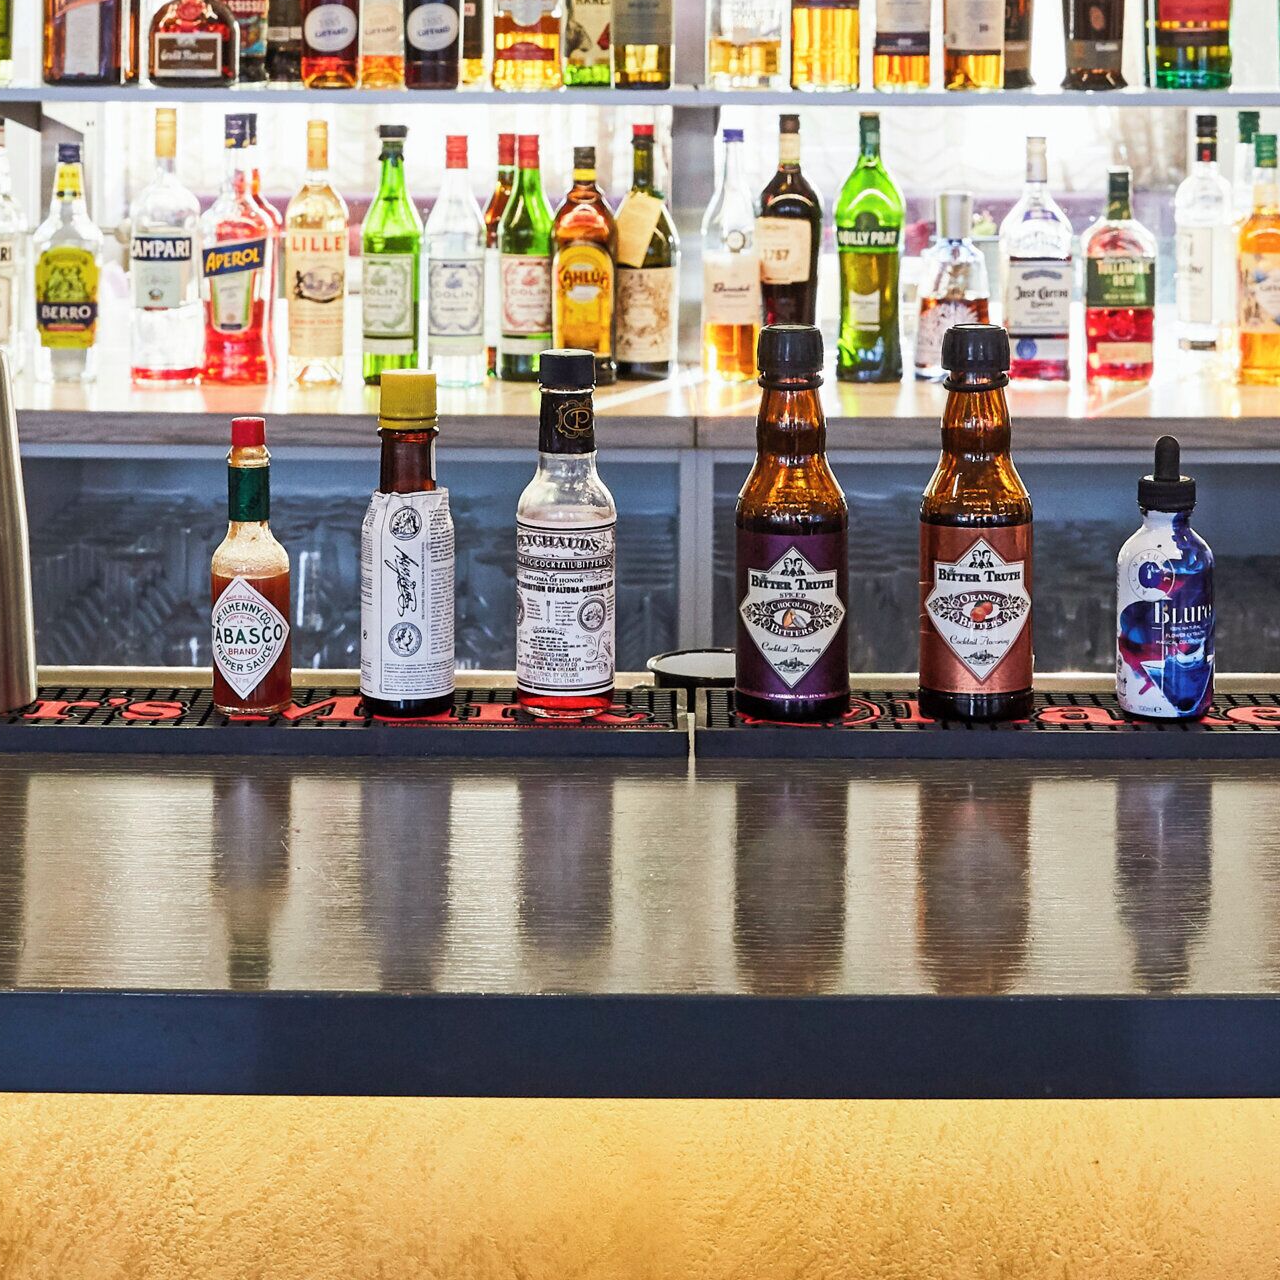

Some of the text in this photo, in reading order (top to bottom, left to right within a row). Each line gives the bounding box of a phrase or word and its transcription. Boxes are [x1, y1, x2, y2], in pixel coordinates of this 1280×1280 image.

[131, 237, 192, 259] CAMPARI
[206, 250, 260, 272] APEROL
[39, 304, 91, 320] BERRO
[535, 559, 607, 569] COCKTAIL BITTERS
[983, 570, 1021, 583] TRUTH
[795, 577, 834, 591] TRUTH
[770, 600, 814, 612] CHOCOLATE
[959, 593, 1002, 605] ORANGE
[958, 615, 1003, 630] BITTERS
[770, 624, 814, 638] BITTERS
[761, 641, 822, 654] Cocktail Flavoring
[949, 635, 978, 646] Cocktail
[216, 644, 274, 672] PEPPER SAUCE
